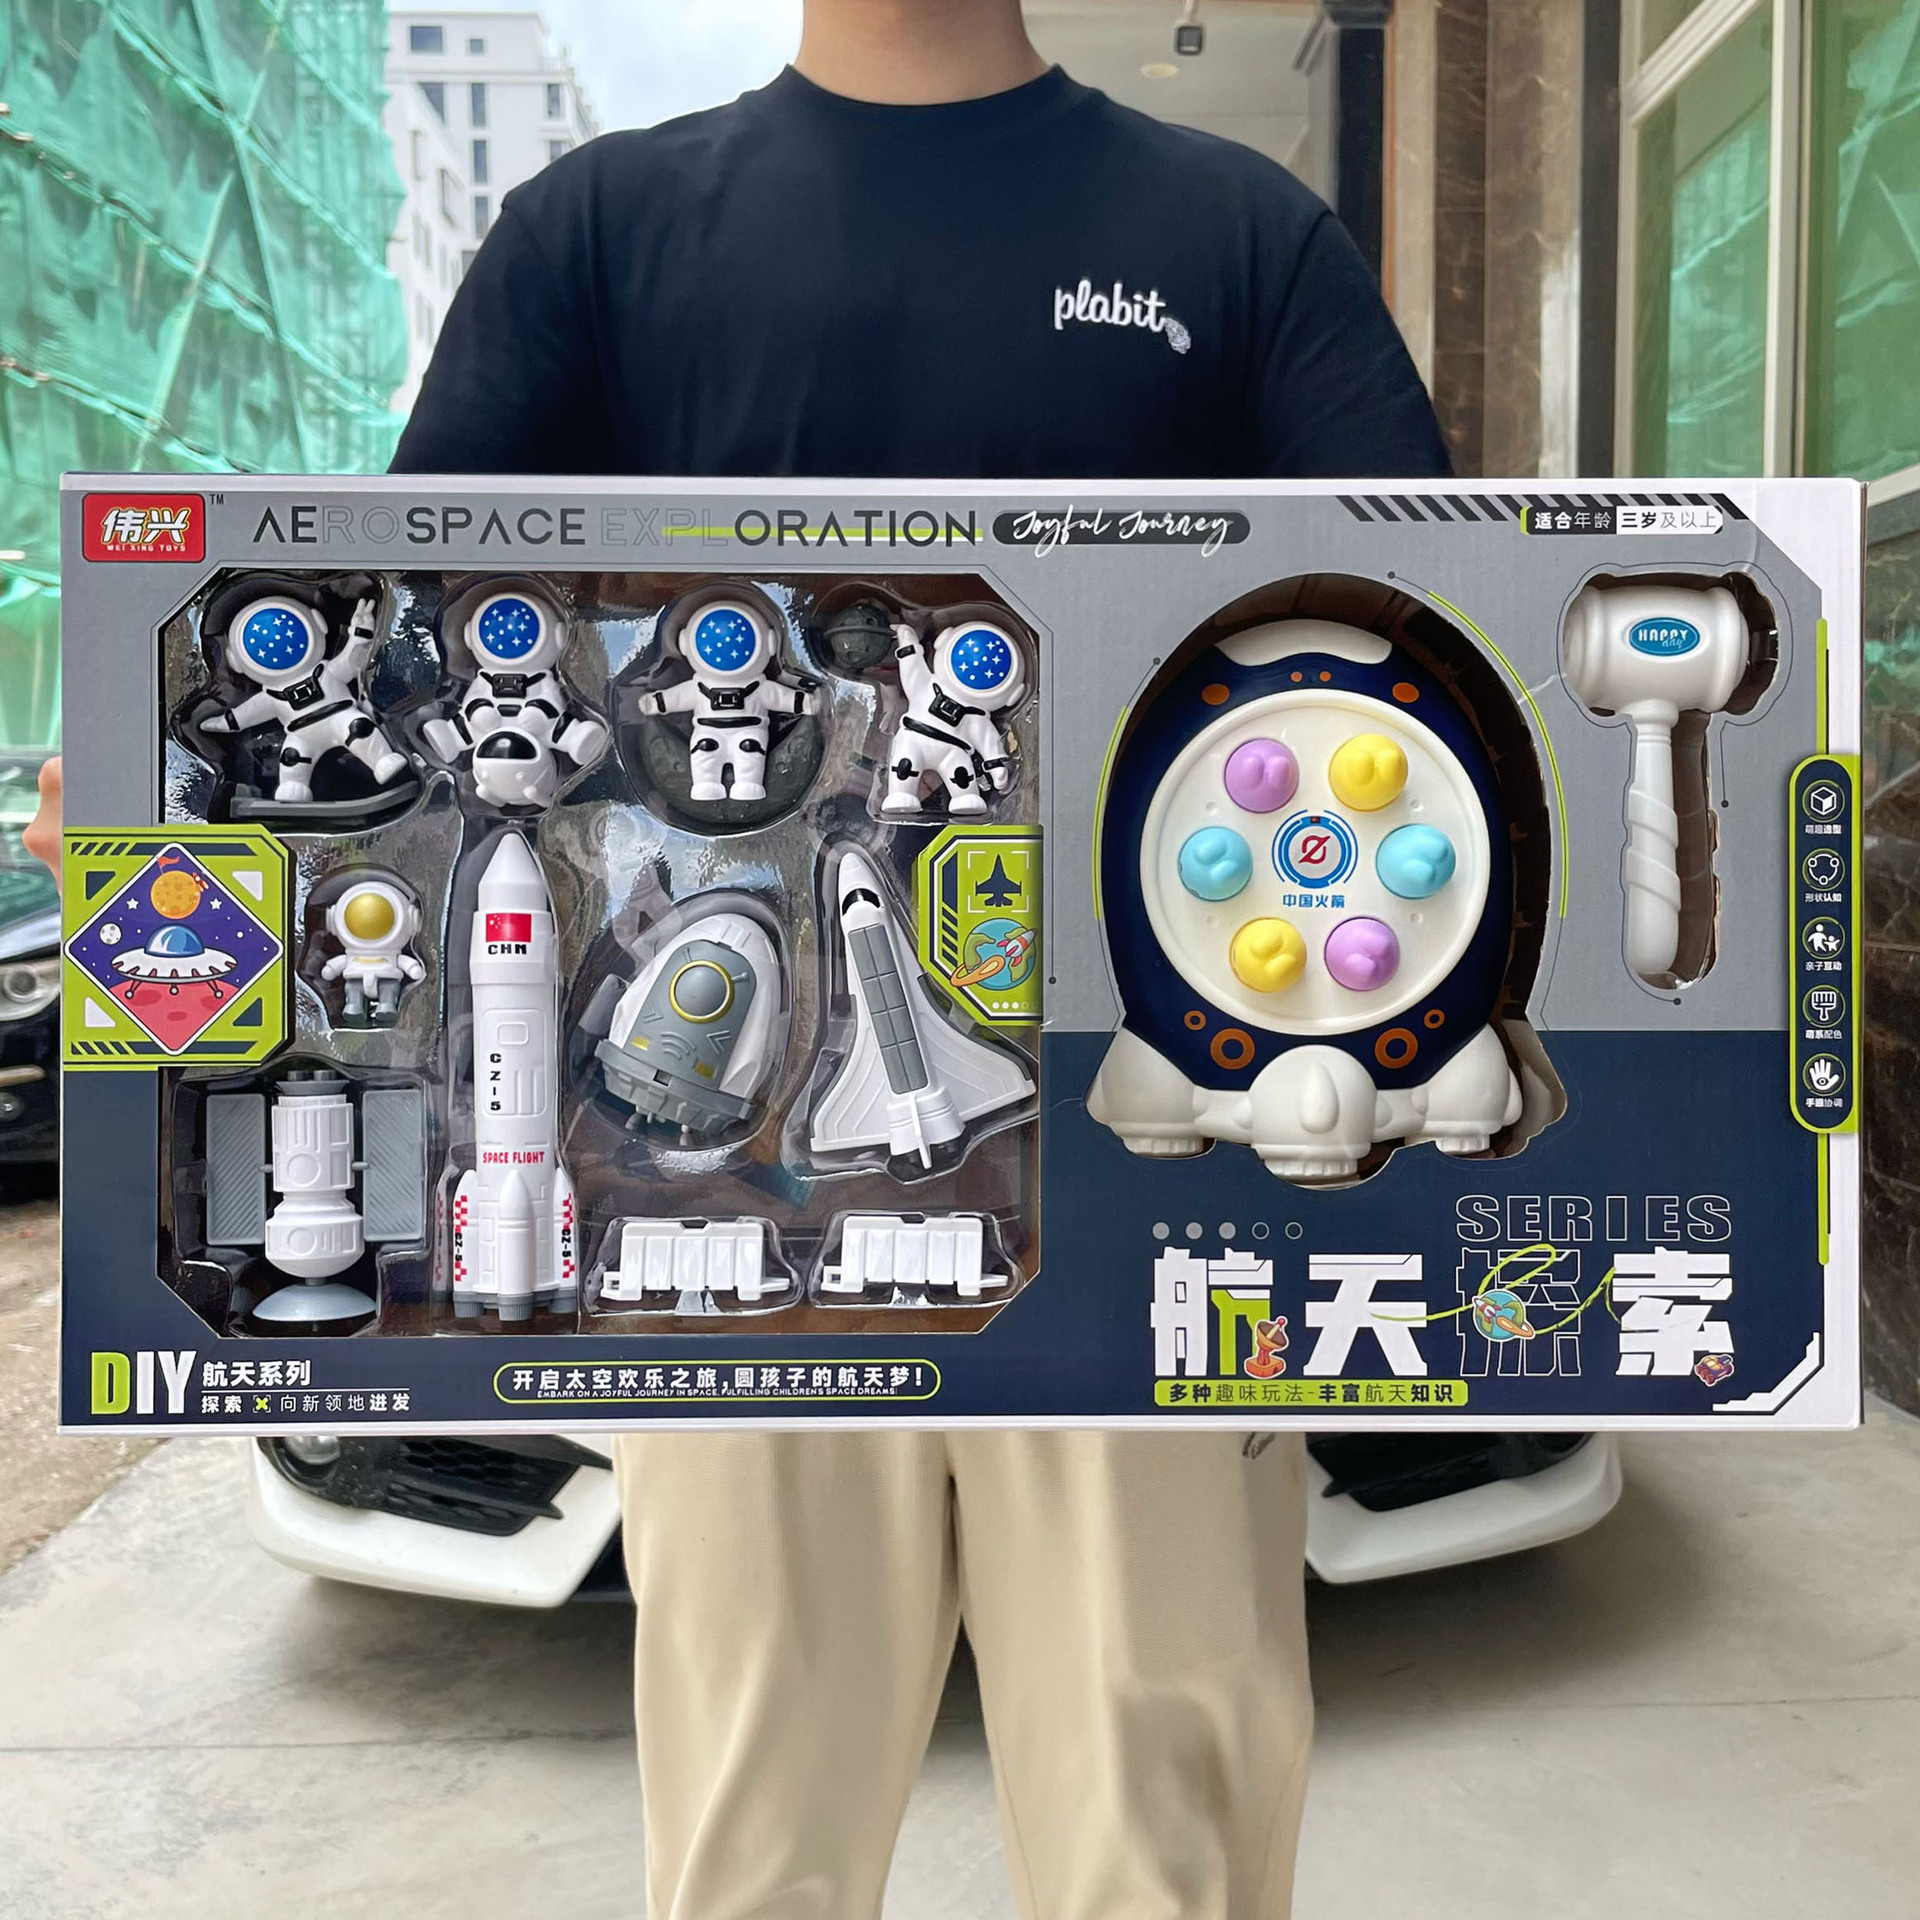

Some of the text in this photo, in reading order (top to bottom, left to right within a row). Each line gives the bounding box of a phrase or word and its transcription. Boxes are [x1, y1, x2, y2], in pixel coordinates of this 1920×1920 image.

[1054, 277, 1168, 333] plabit
[210, 494, 225, 505] TM
[103, 509, 190, 544] 伟兴
[252, 505, 977, 548] AEROSPACE EXPLORATION
[1534, 511, 1717, 530] 适合年龄 三岁及以上
[1012, 504, 1234, 558] Joyful Journey
[160, 544, 186, 552] TOYS
[1638, 628, 1689, 642] HAPPY
[1283, 894, 1345, 908] 中国火箭
[487, 944, 527, 955] CHN
[1805, 961, 1843, 972] 亲子互动
[483, 1151, 545, 1164] SPACE FLIGHT
[1455, 1194, 1733, 1243] SERIES
[1150, 1246, 1735, 1377] 航天探索
[91, 1351, 197, 1415] DIY
[202, 1360, 312, 1388] 航天系列
[537, 1390, 575, 1398] EMBARK
[577, 1390, 590, 1398] ON
[592, 1390, 599, 1398] A
[600, 1389, 633, 1397] JOYFUL
[634, 1389, 674, 1397] JOURNEY
[676, 1389, 686, 1397] IN
[826, 1387, 856, 1395] SPACE
[201, 1395, 243, 1414] 探索
